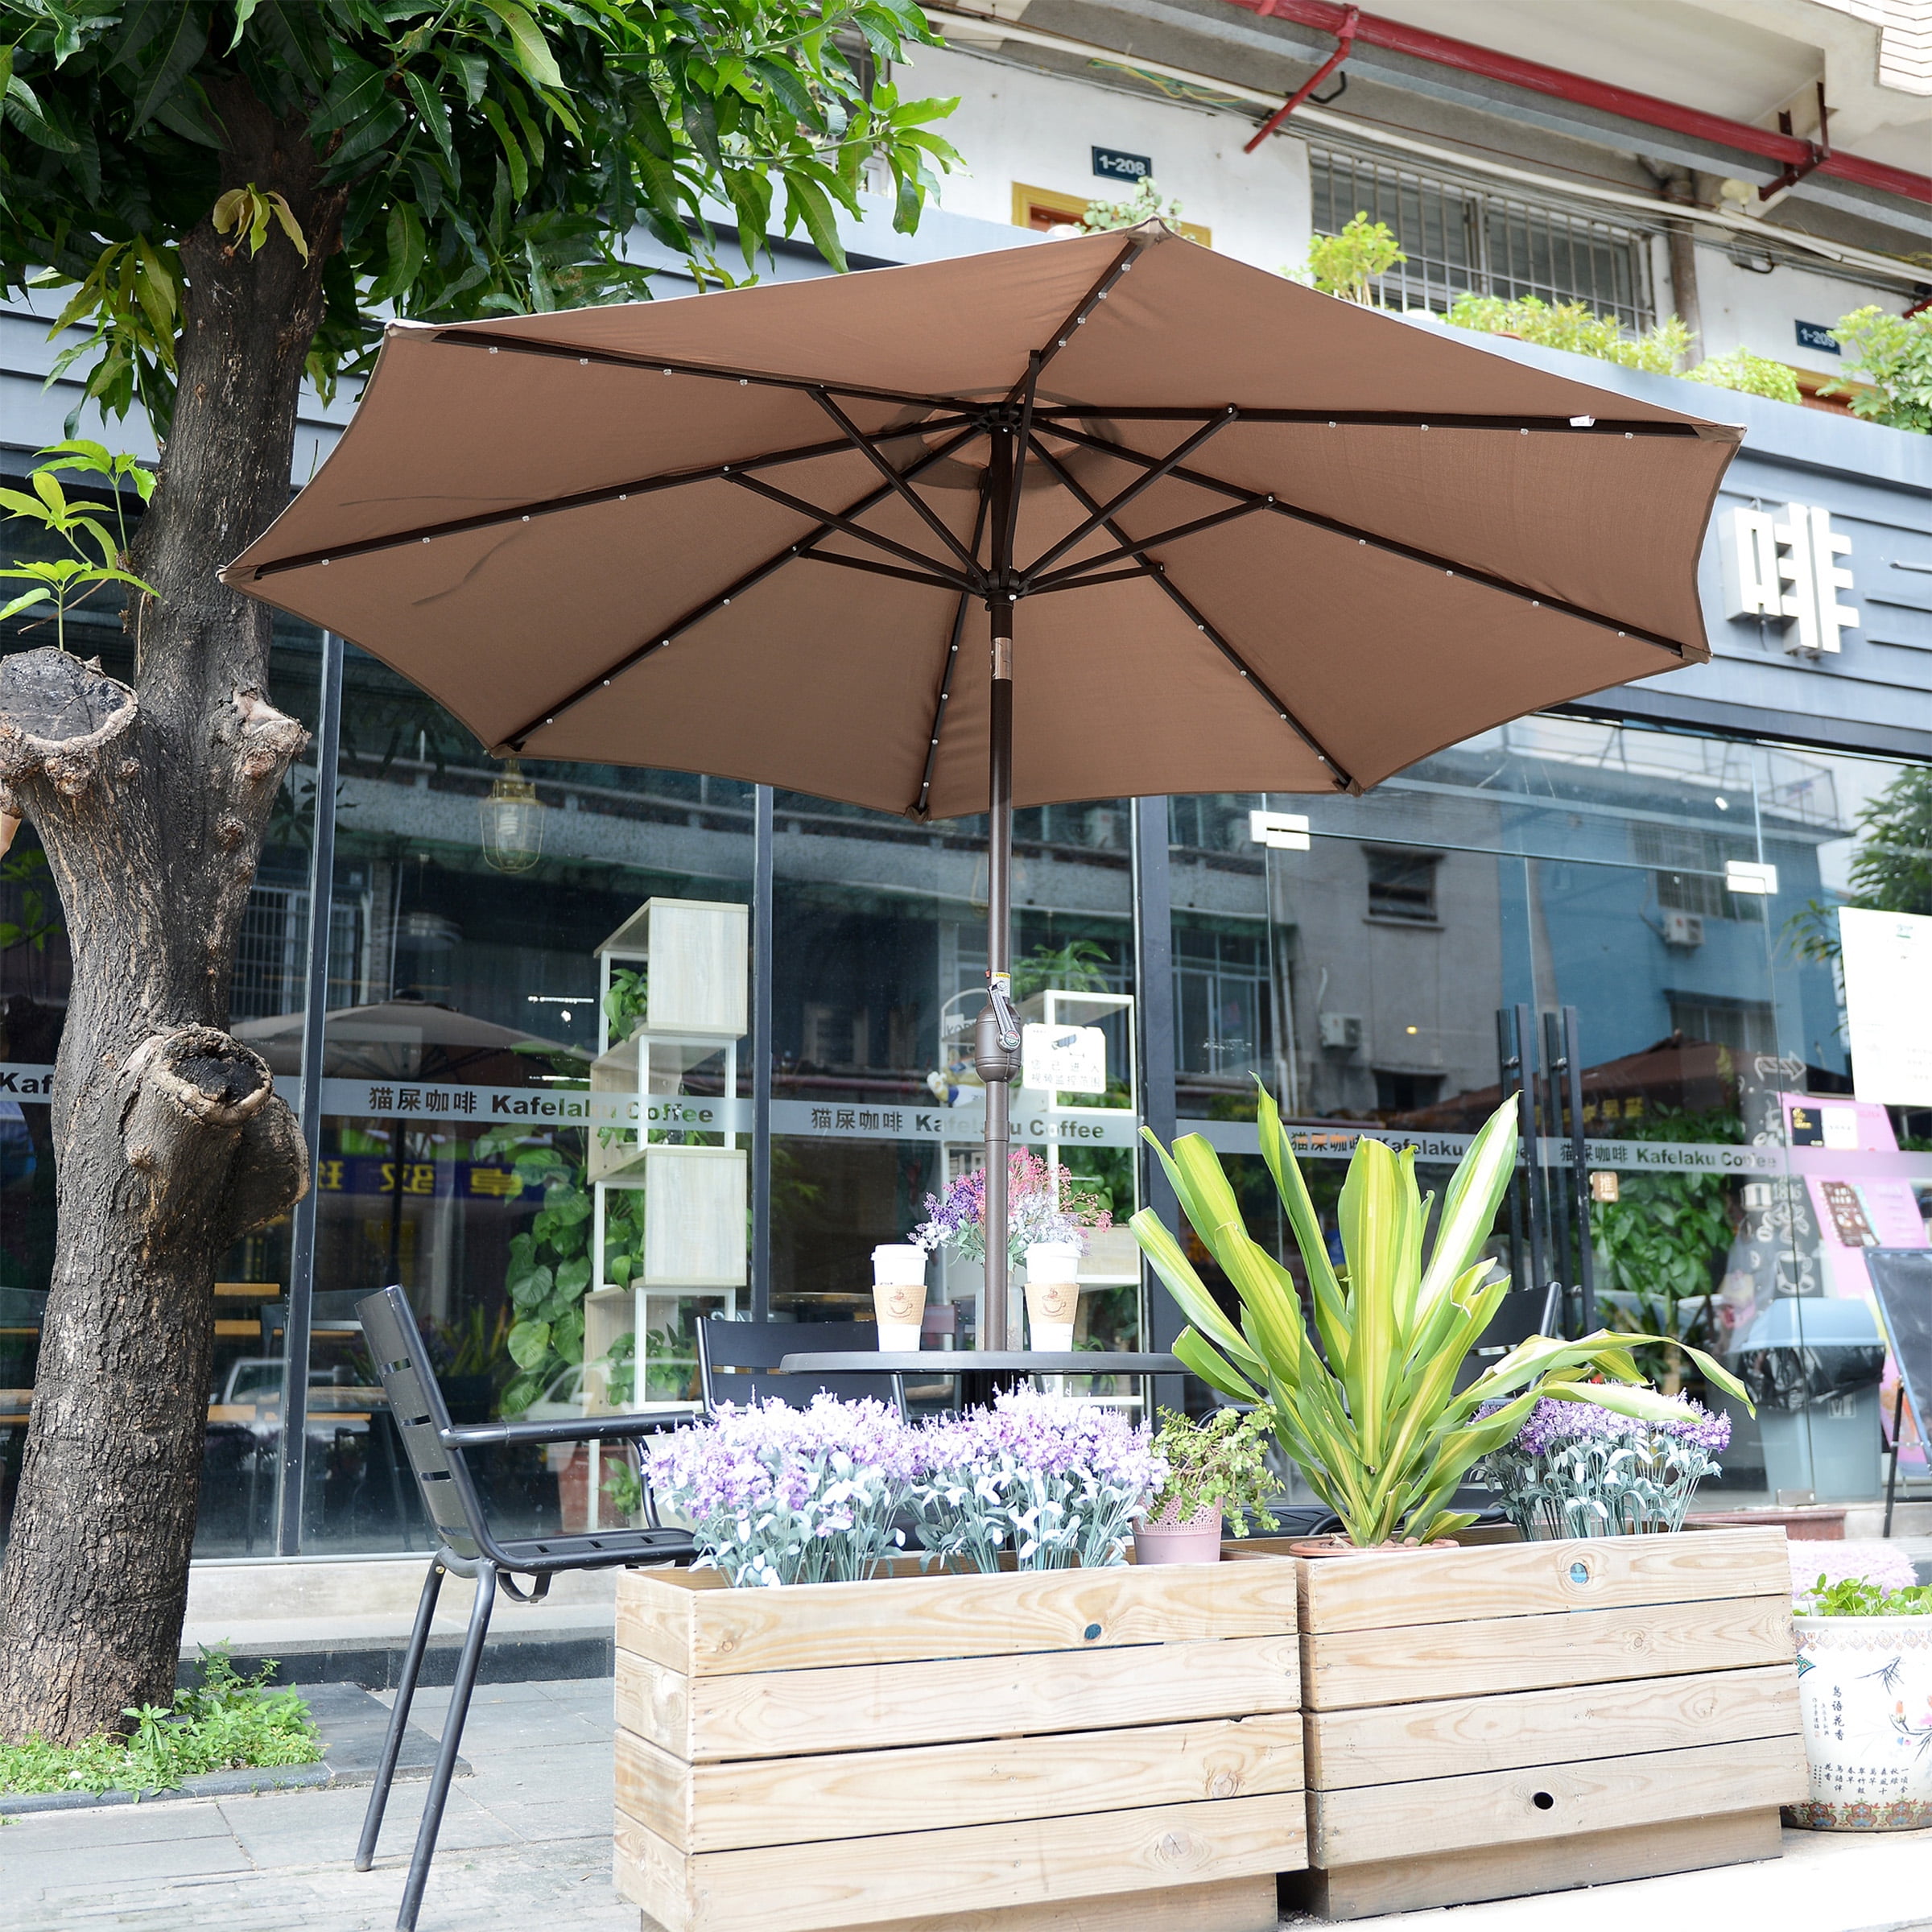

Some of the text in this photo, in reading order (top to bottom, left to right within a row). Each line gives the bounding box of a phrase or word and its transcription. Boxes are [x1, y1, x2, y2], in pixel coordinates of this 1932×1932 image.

[1099, 155, 1146, 175] 1-208
[1727, 502, 1860, 654] 啡
[369, 1087, 714, 1123] 猫屎咖啡 Kafelaku Coffee
[811, 1107, 902, 1132] 猫屎咖啡
[1637, 1148, 1716, 1166] Kafelaku
[1600, 1174, 1613, 1191] 推
